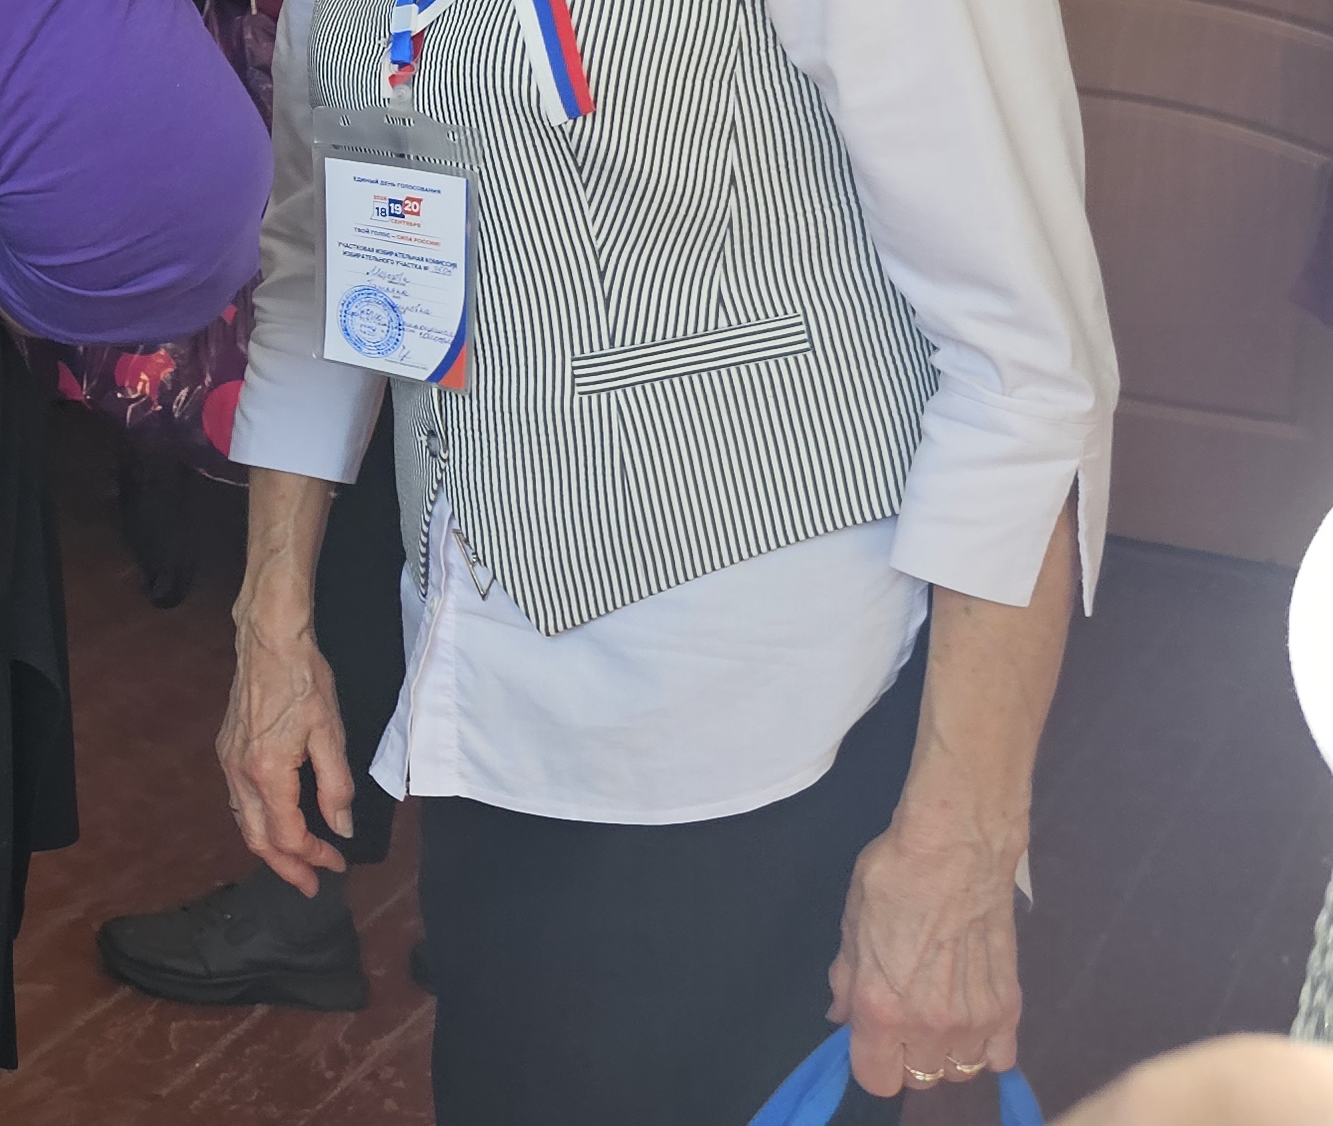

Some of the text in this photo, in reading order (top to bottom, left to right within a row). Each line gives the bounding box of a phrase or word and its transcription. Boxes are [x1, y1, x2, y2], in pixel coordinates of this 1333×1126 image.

[353, 176, 441, 194] ЕДИНЫЙ ДЕНЬ ГОЛОСОВАНИЯ
[375, 200, 419, 217] 18 19 20
[354, 226, 369, 235] ТВОЙ
[390, 218, 421, 228] СЕНТЯБРЯ
[338, 241, 457, 269] УЧАСТКОВАЯ ИЗБИРАТЕЛЬНАЯ КОМИССИЯ
[343, 250, 394, 265] ИЗБИРАТЕЛЬНОГО
[396, 260, 422, 271] УЧАСТКА
